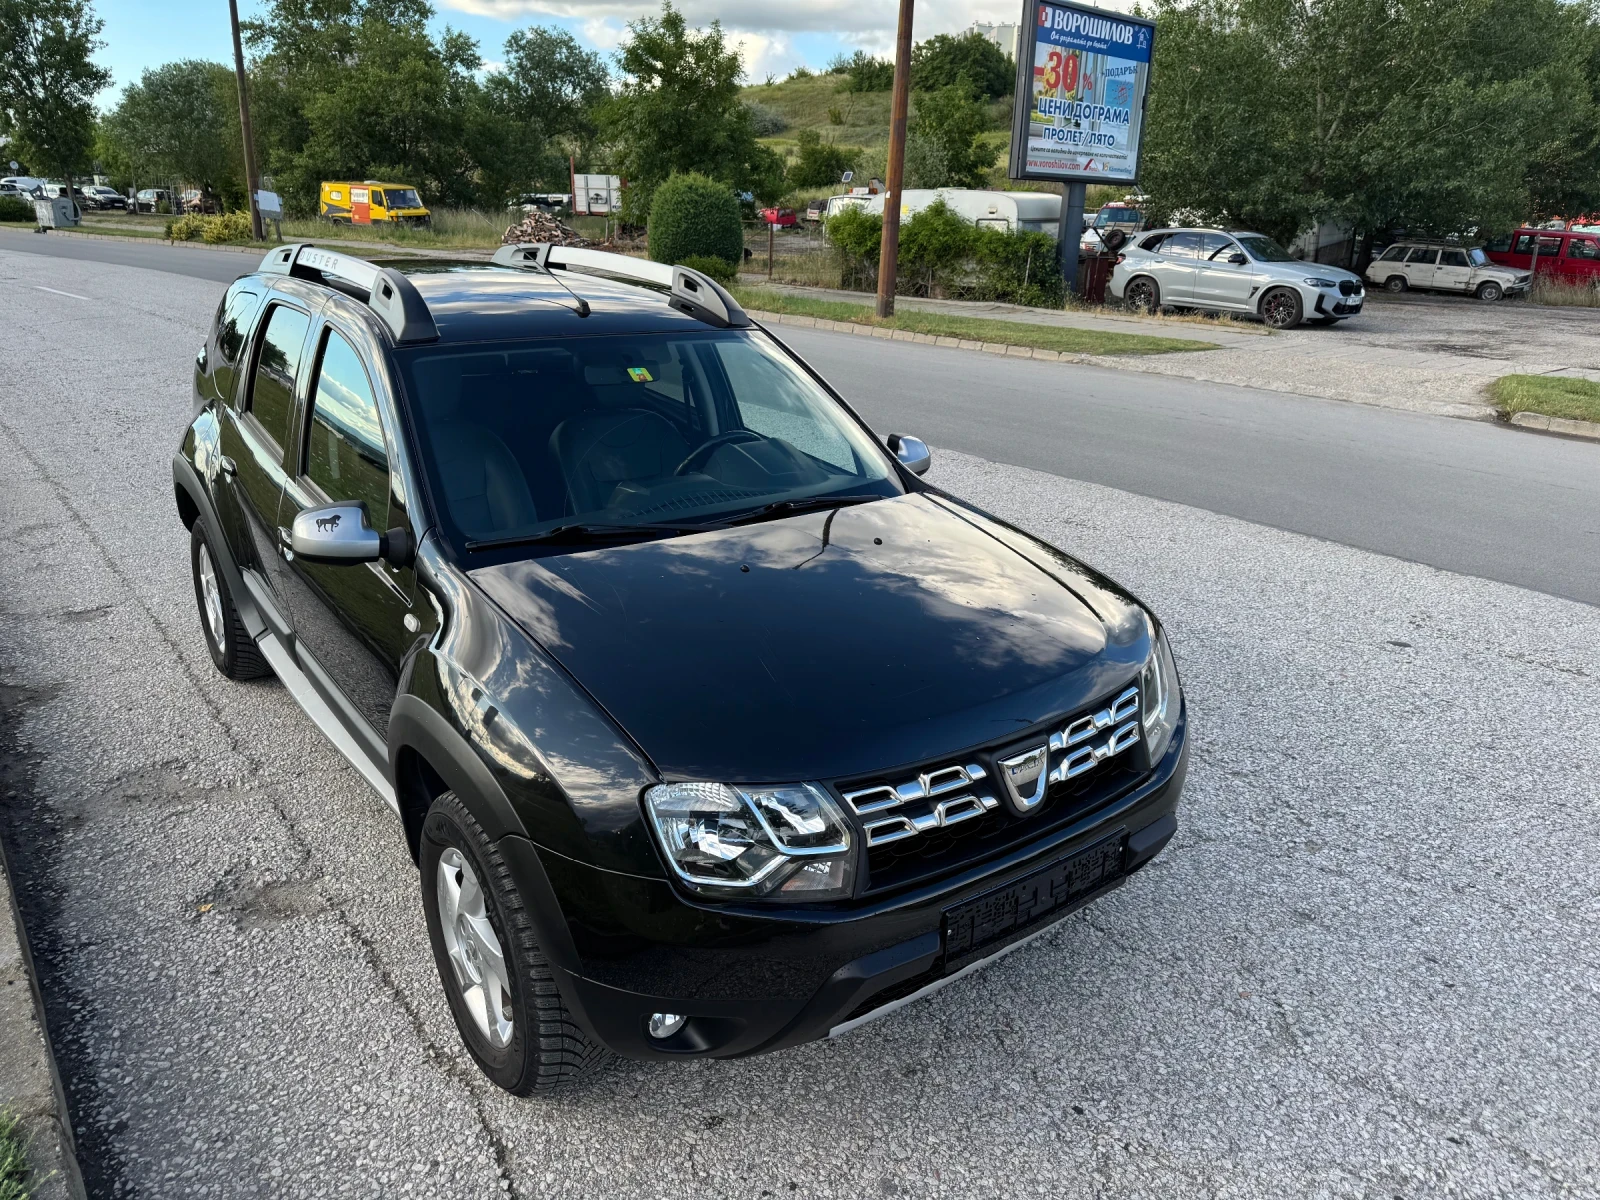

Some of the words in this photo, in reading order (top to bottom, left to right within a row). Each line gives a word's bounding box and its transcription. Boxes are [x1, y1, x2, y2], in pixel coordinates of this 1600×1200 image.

[1054, 9, 1133, 45] ВОРОШИЛОВ
[1039, 97, 1072, 117] ЦЕНИ
[1072, 103, 1130, 124] ДОГРАМА
[299, 250, 339, 270] DUSTER
